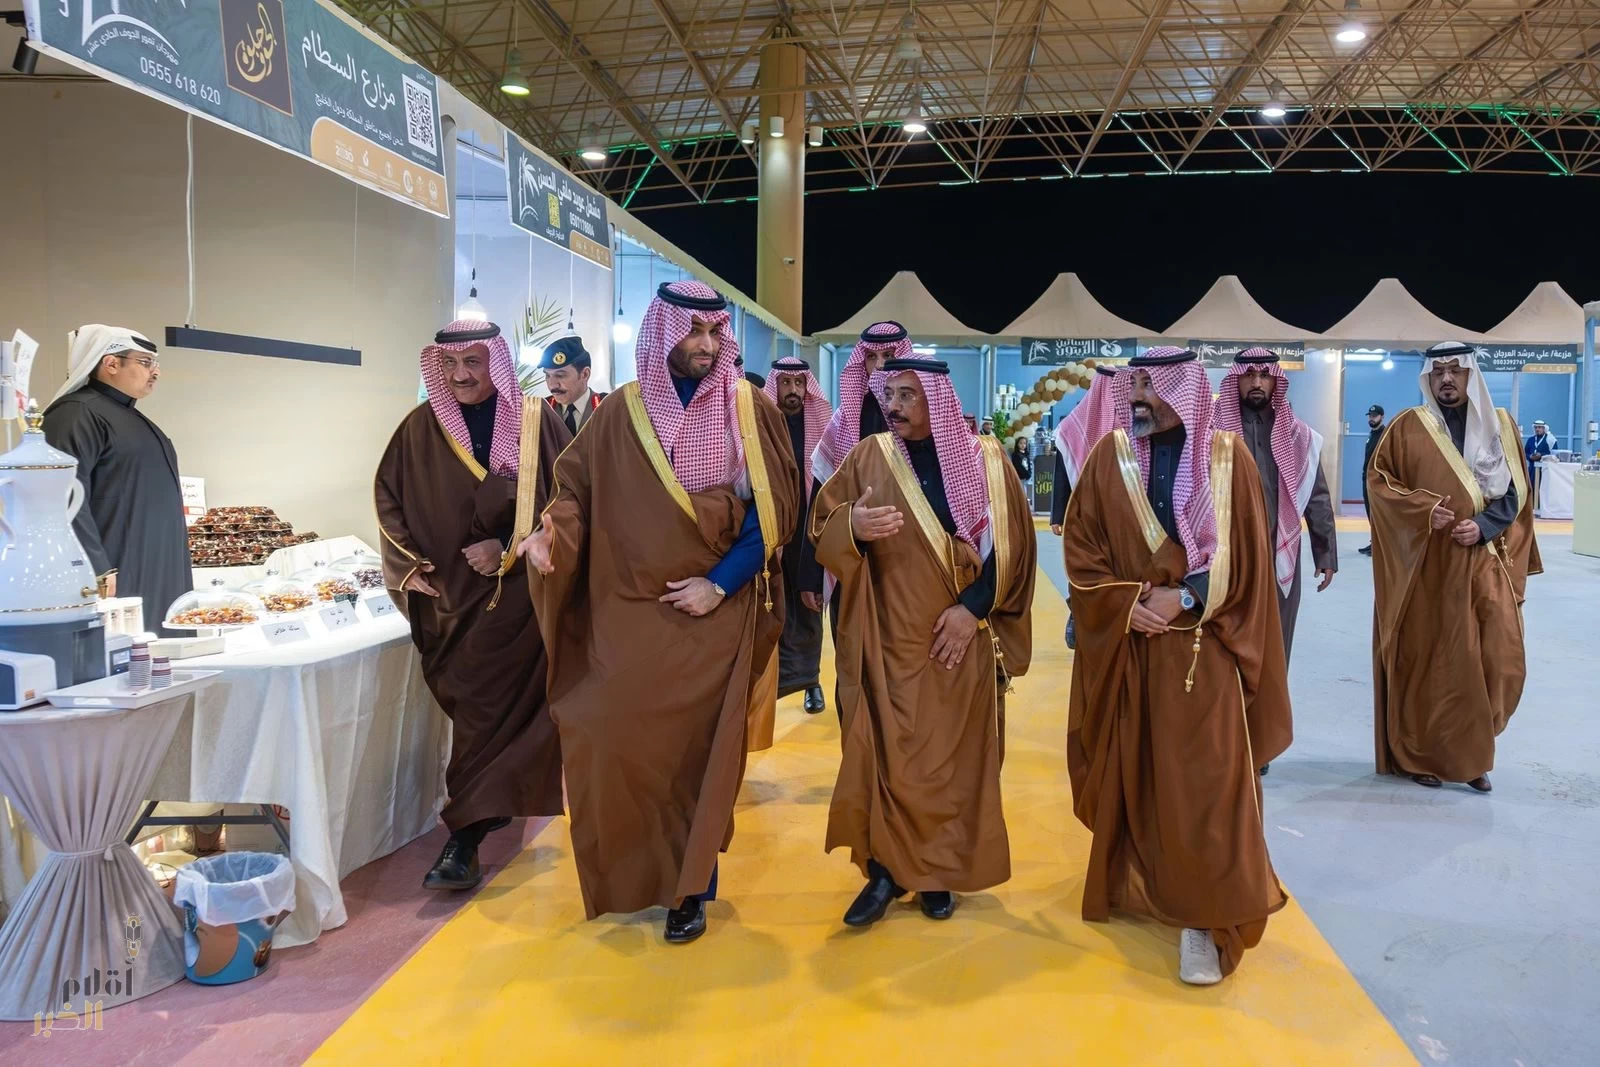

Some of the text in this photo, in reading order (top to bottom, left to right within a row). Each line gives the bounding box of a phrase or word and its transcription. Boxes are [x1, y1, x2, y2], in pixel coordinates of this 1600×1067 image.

[86, 27, 179, 66] مهرجان تمور الجوف الحادي عشر
[301, 29, 396, 111] مزارع السطام
[139, 56, 221, 106] 0555 618 620
[314, 93, 332, 107] الخليج
[332, 100, 346, 118] ودول
[346, 107, 364, 125] المملكة
[363, 119, 378, 134] مناطق
[391, 137, 404, 147] شحن
[537, 167, 557, 193] الحسن
[585, 194, 601, 220] مشعل
[1517, 349, 1536, 359] مرشد
[1536, 350, 1549, 361] علي
